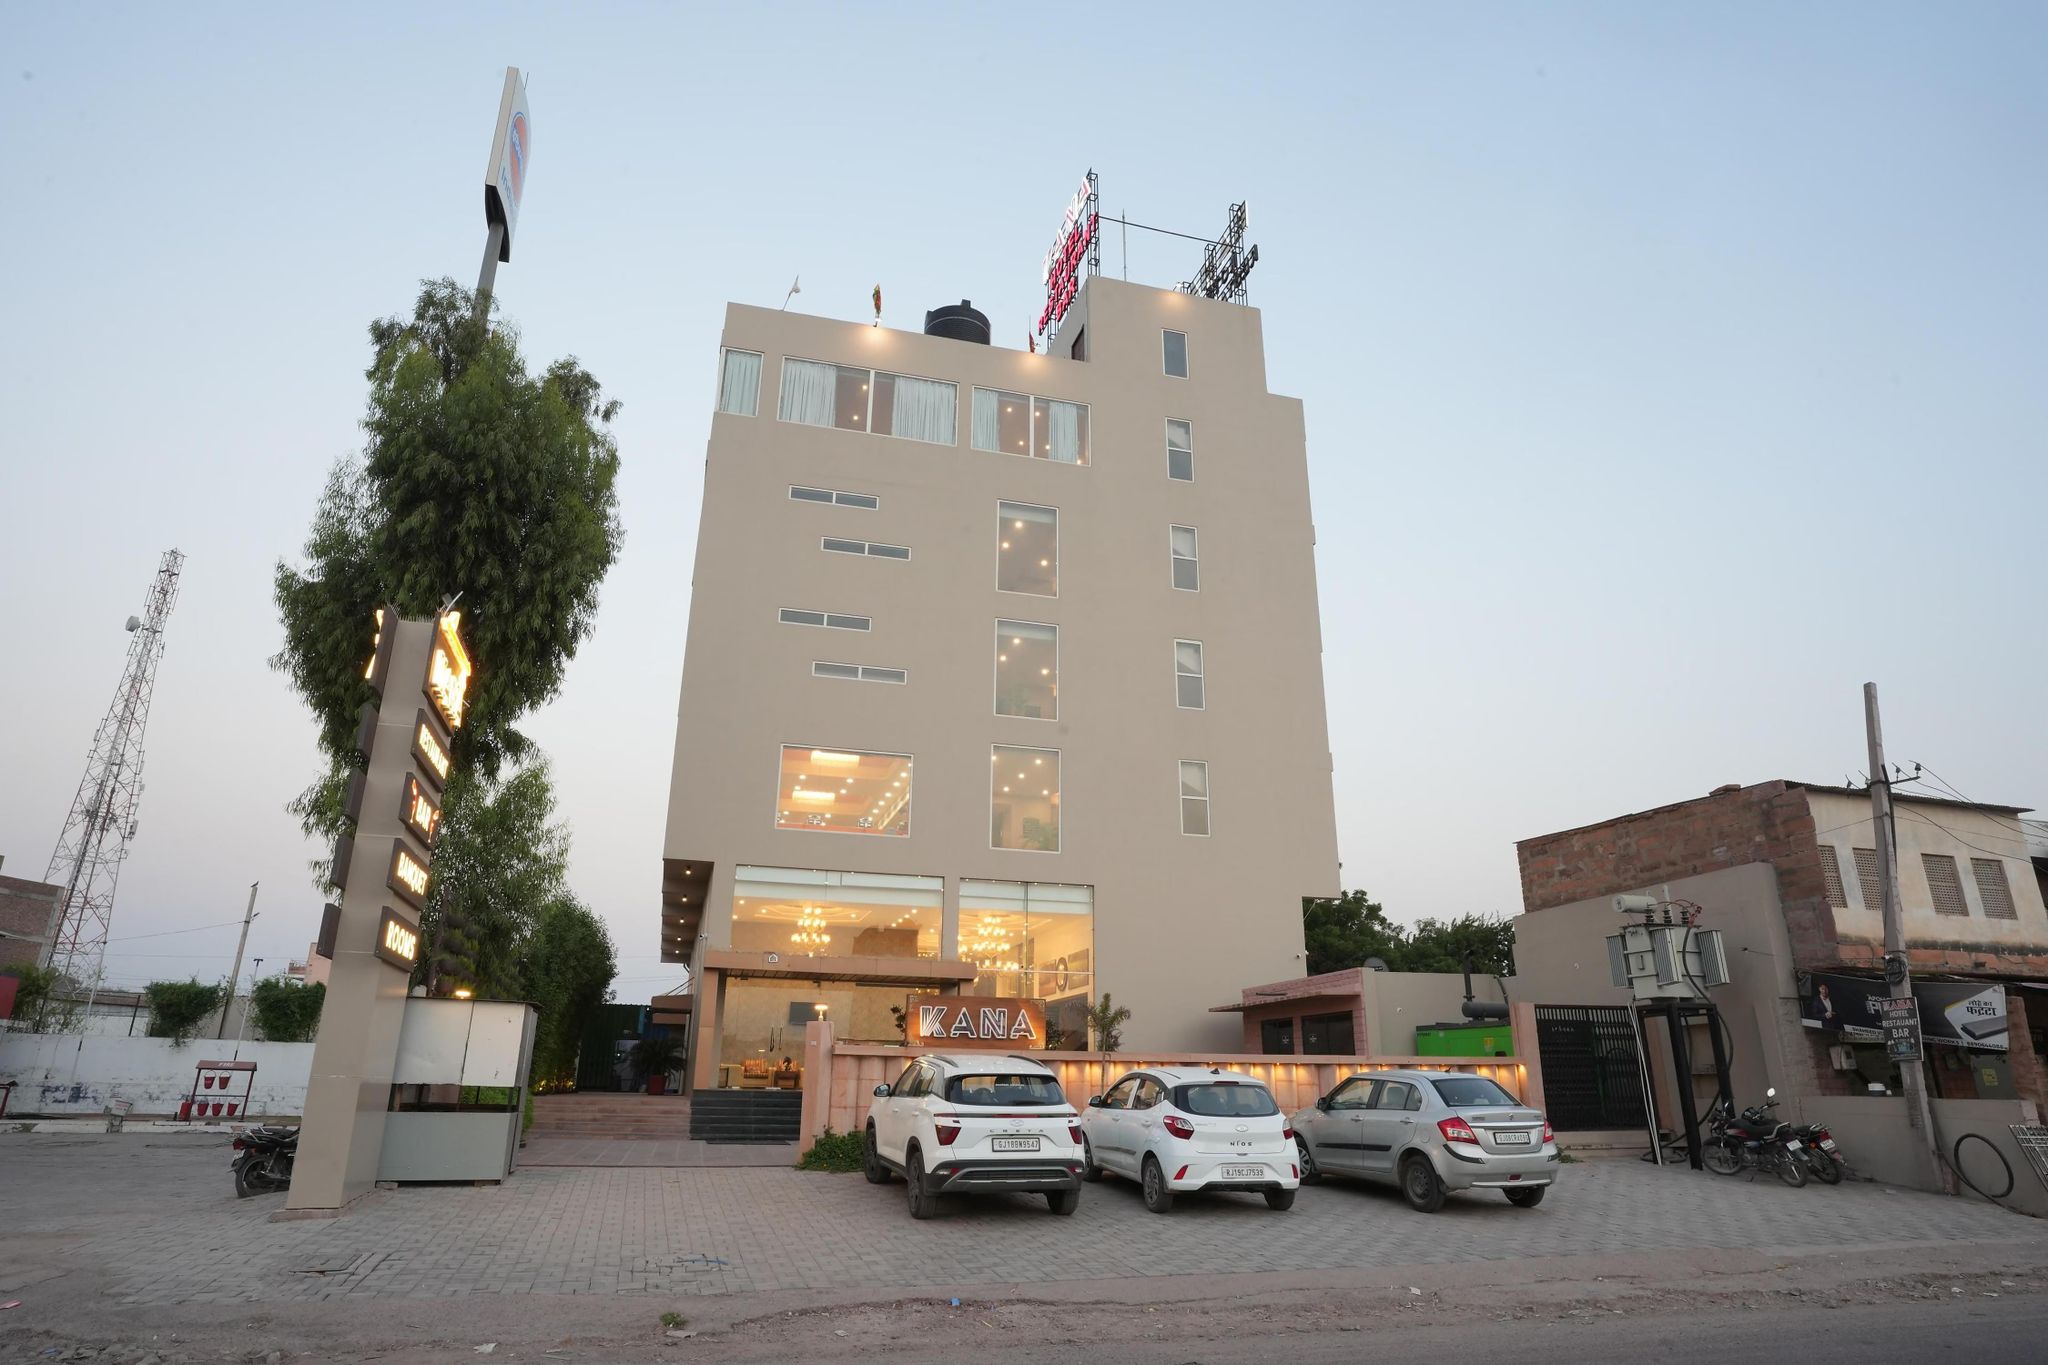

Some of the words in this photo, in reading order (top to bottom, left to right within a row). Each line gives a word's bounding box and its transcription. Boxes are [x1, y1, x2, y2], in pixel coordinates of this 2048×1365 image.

[1050, 224, 1080, 290] HOTEL
[1056, 275, 1076, 322] BAR
[397, 851, 428, 896] BANQUET
[385, 920, 416, 960] ROOMS
[919, 1005, 1036, 1039] KANA
[1889, 1010, 1909, 1018] HOTEL
[1892, 1028, 1910, 1038] BAR
